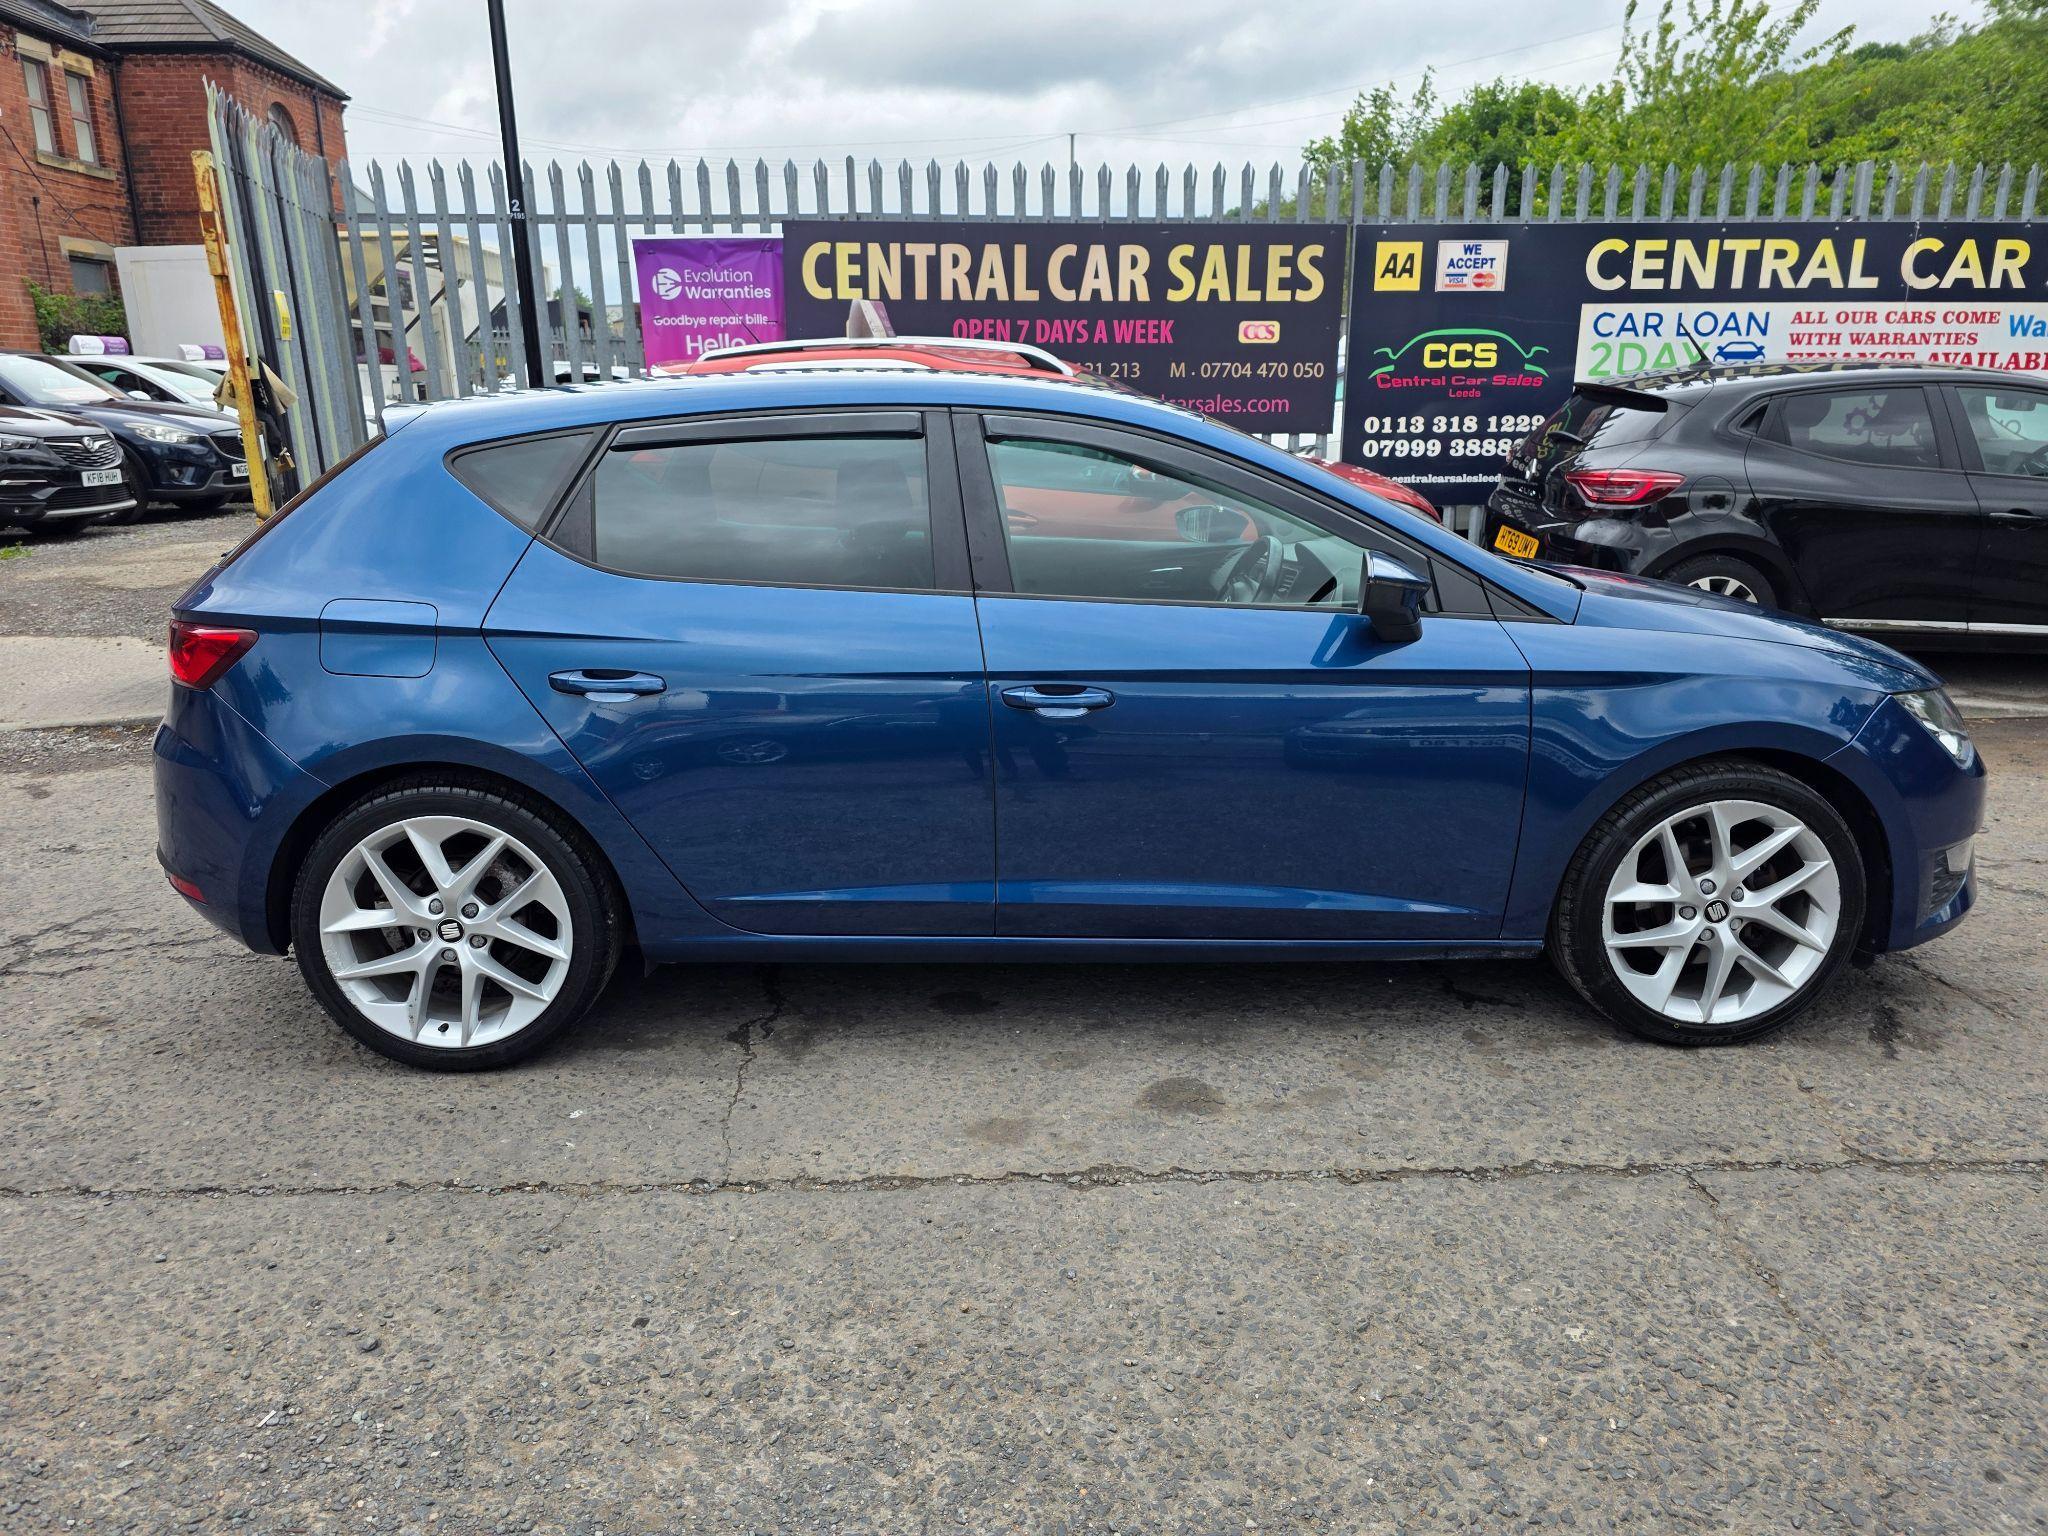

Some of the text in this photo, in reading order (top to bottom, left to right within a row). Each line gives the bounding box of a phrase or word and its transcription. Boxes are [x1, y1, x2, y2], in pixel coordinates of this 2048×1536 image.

[511, 199, 521, 211] 2
[1463, 243, 1482, 255] WE
[802, 241, 1325, 302] CENTRAL CAR SALES
[1380, 253, 1415, 278] AA
[1447, 258, 1496, 269] ACCEPT
[1585, 238, 2031, 290] CENTRAL CAR
[684, 268, 753, 283] Evolution
[685, 284, 772, 299] Warranties
[653, 314, 707, 328] Goodbye
[709, 314, 742, 328] repair
[1593, 311, 1770, 338] CAR LOAN
[1790, 311, 2000, 325] ALL OUR CARS COME
[2009, 314, 2048, 338] Wa
[953, 319, 1175, 344] OPEN 7 DAYS A WEEK
[1789, 332, 1978, 345] WITH WARRANTIES
[1423, 343, 1498, 368] CCS
[1110, 362, 1140, 378] 213
[1201, 362, 1251, 378] 07704
[1257, 362, 1288, 378] 470
[1293, 362, 1324, 378] 050
[1376, 374, 1543, 389] Central Car Sales
[1449, 388, 1481, 398] Leeds
[1364, 416, 1425, 434] 0113
[1432, 415, 1478, 433] 318
[1362, 439, 1442, 457] 07999
